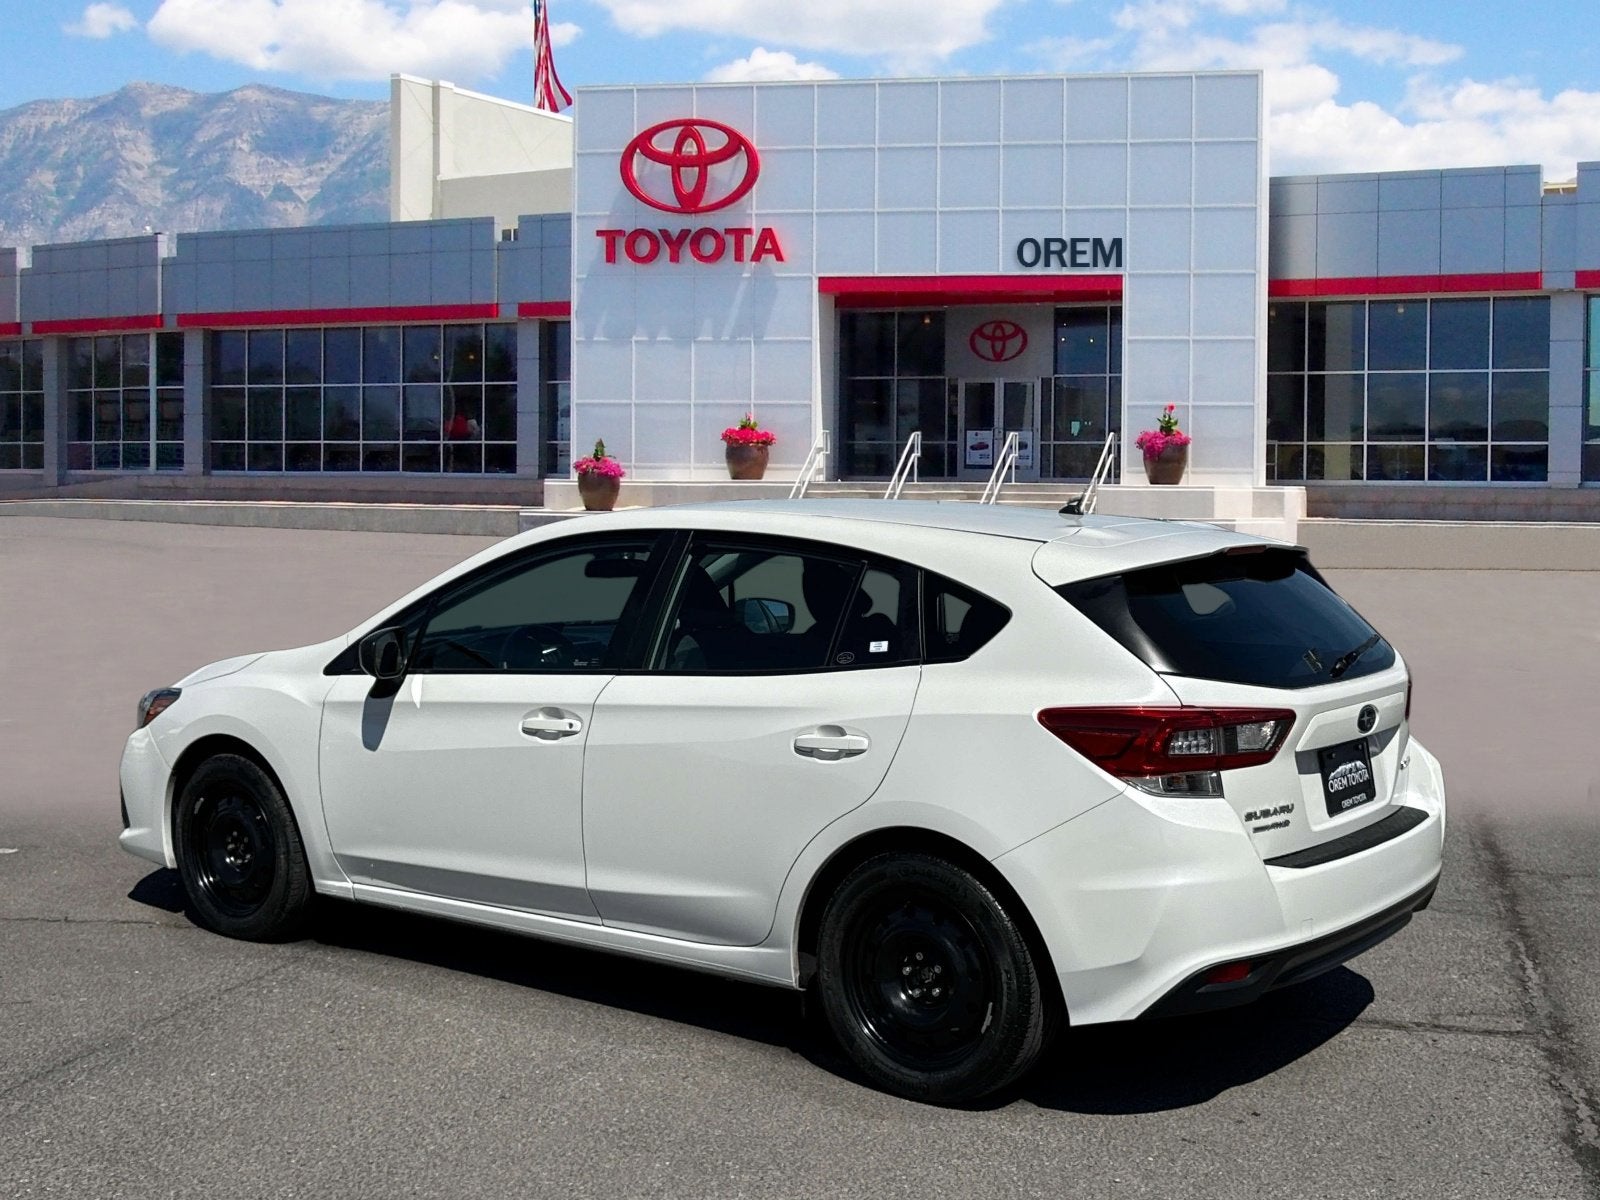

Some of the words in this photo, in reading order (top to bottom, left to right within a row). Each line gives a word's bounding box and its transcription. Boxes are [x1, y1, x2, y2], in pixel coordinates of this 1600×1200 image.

[596, 227, 785, 265] TOYOTA
[1016, 237, 1123, 268] OREM
[1328, 775, 1348, 793] OREM
[1347, 768, 1370, 787] TOYOTA
[1244, 803, 1295, 822] SUBARU
